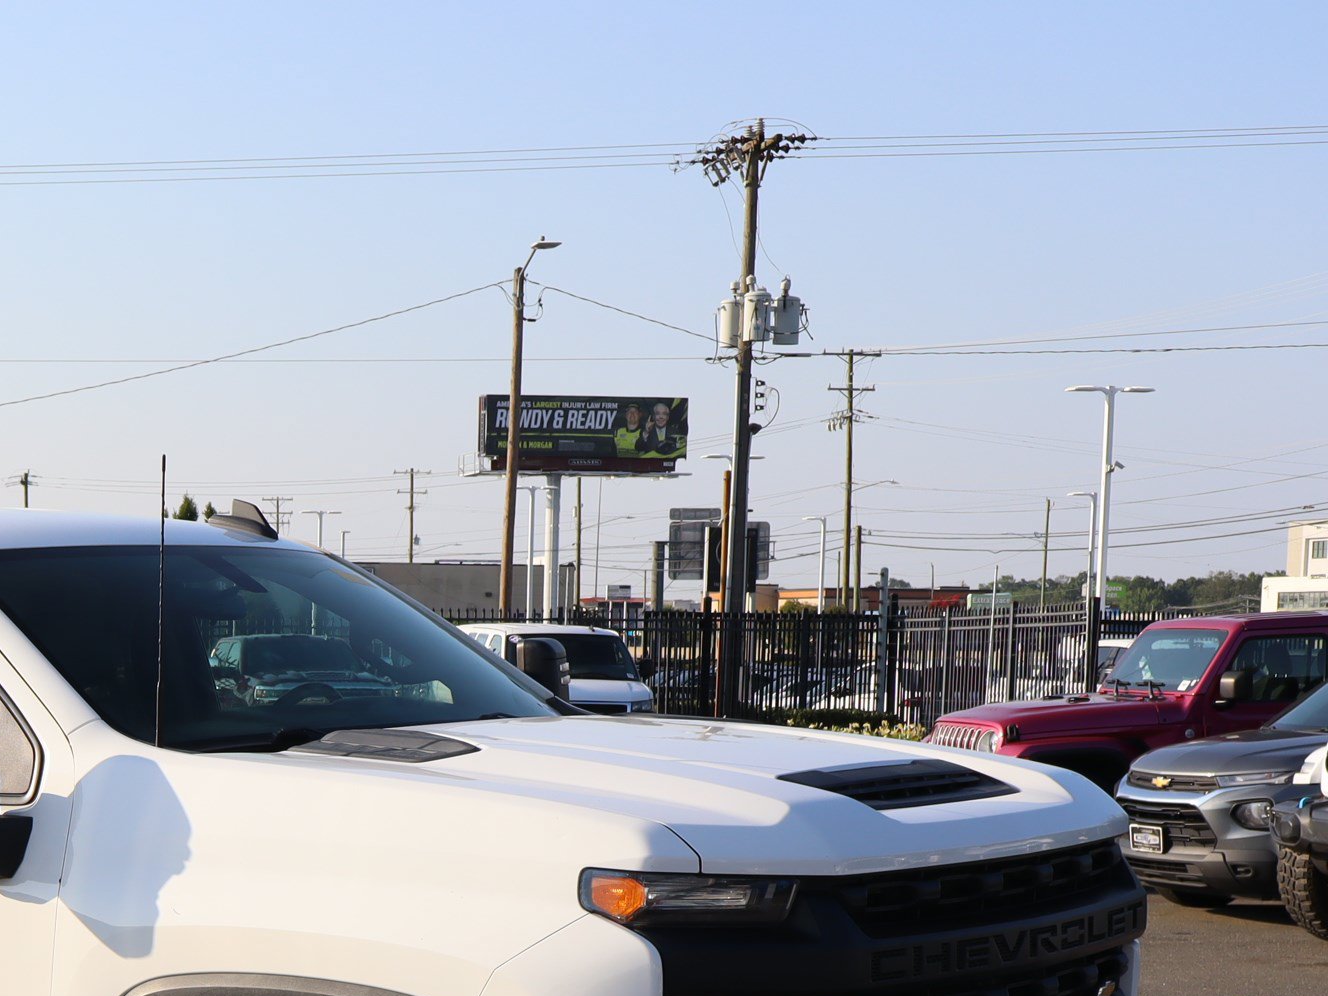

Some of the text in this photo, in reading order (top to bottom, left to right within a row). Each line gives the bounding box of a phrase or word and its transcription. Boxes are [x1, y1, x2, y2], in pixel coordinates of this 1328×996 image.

[553, 410, 564, 429] &
[566, 410, 617, 430] READY
[529, 441, 553, 449] MORGAN
[870, 902, 1144, 983] CHEVROLET
